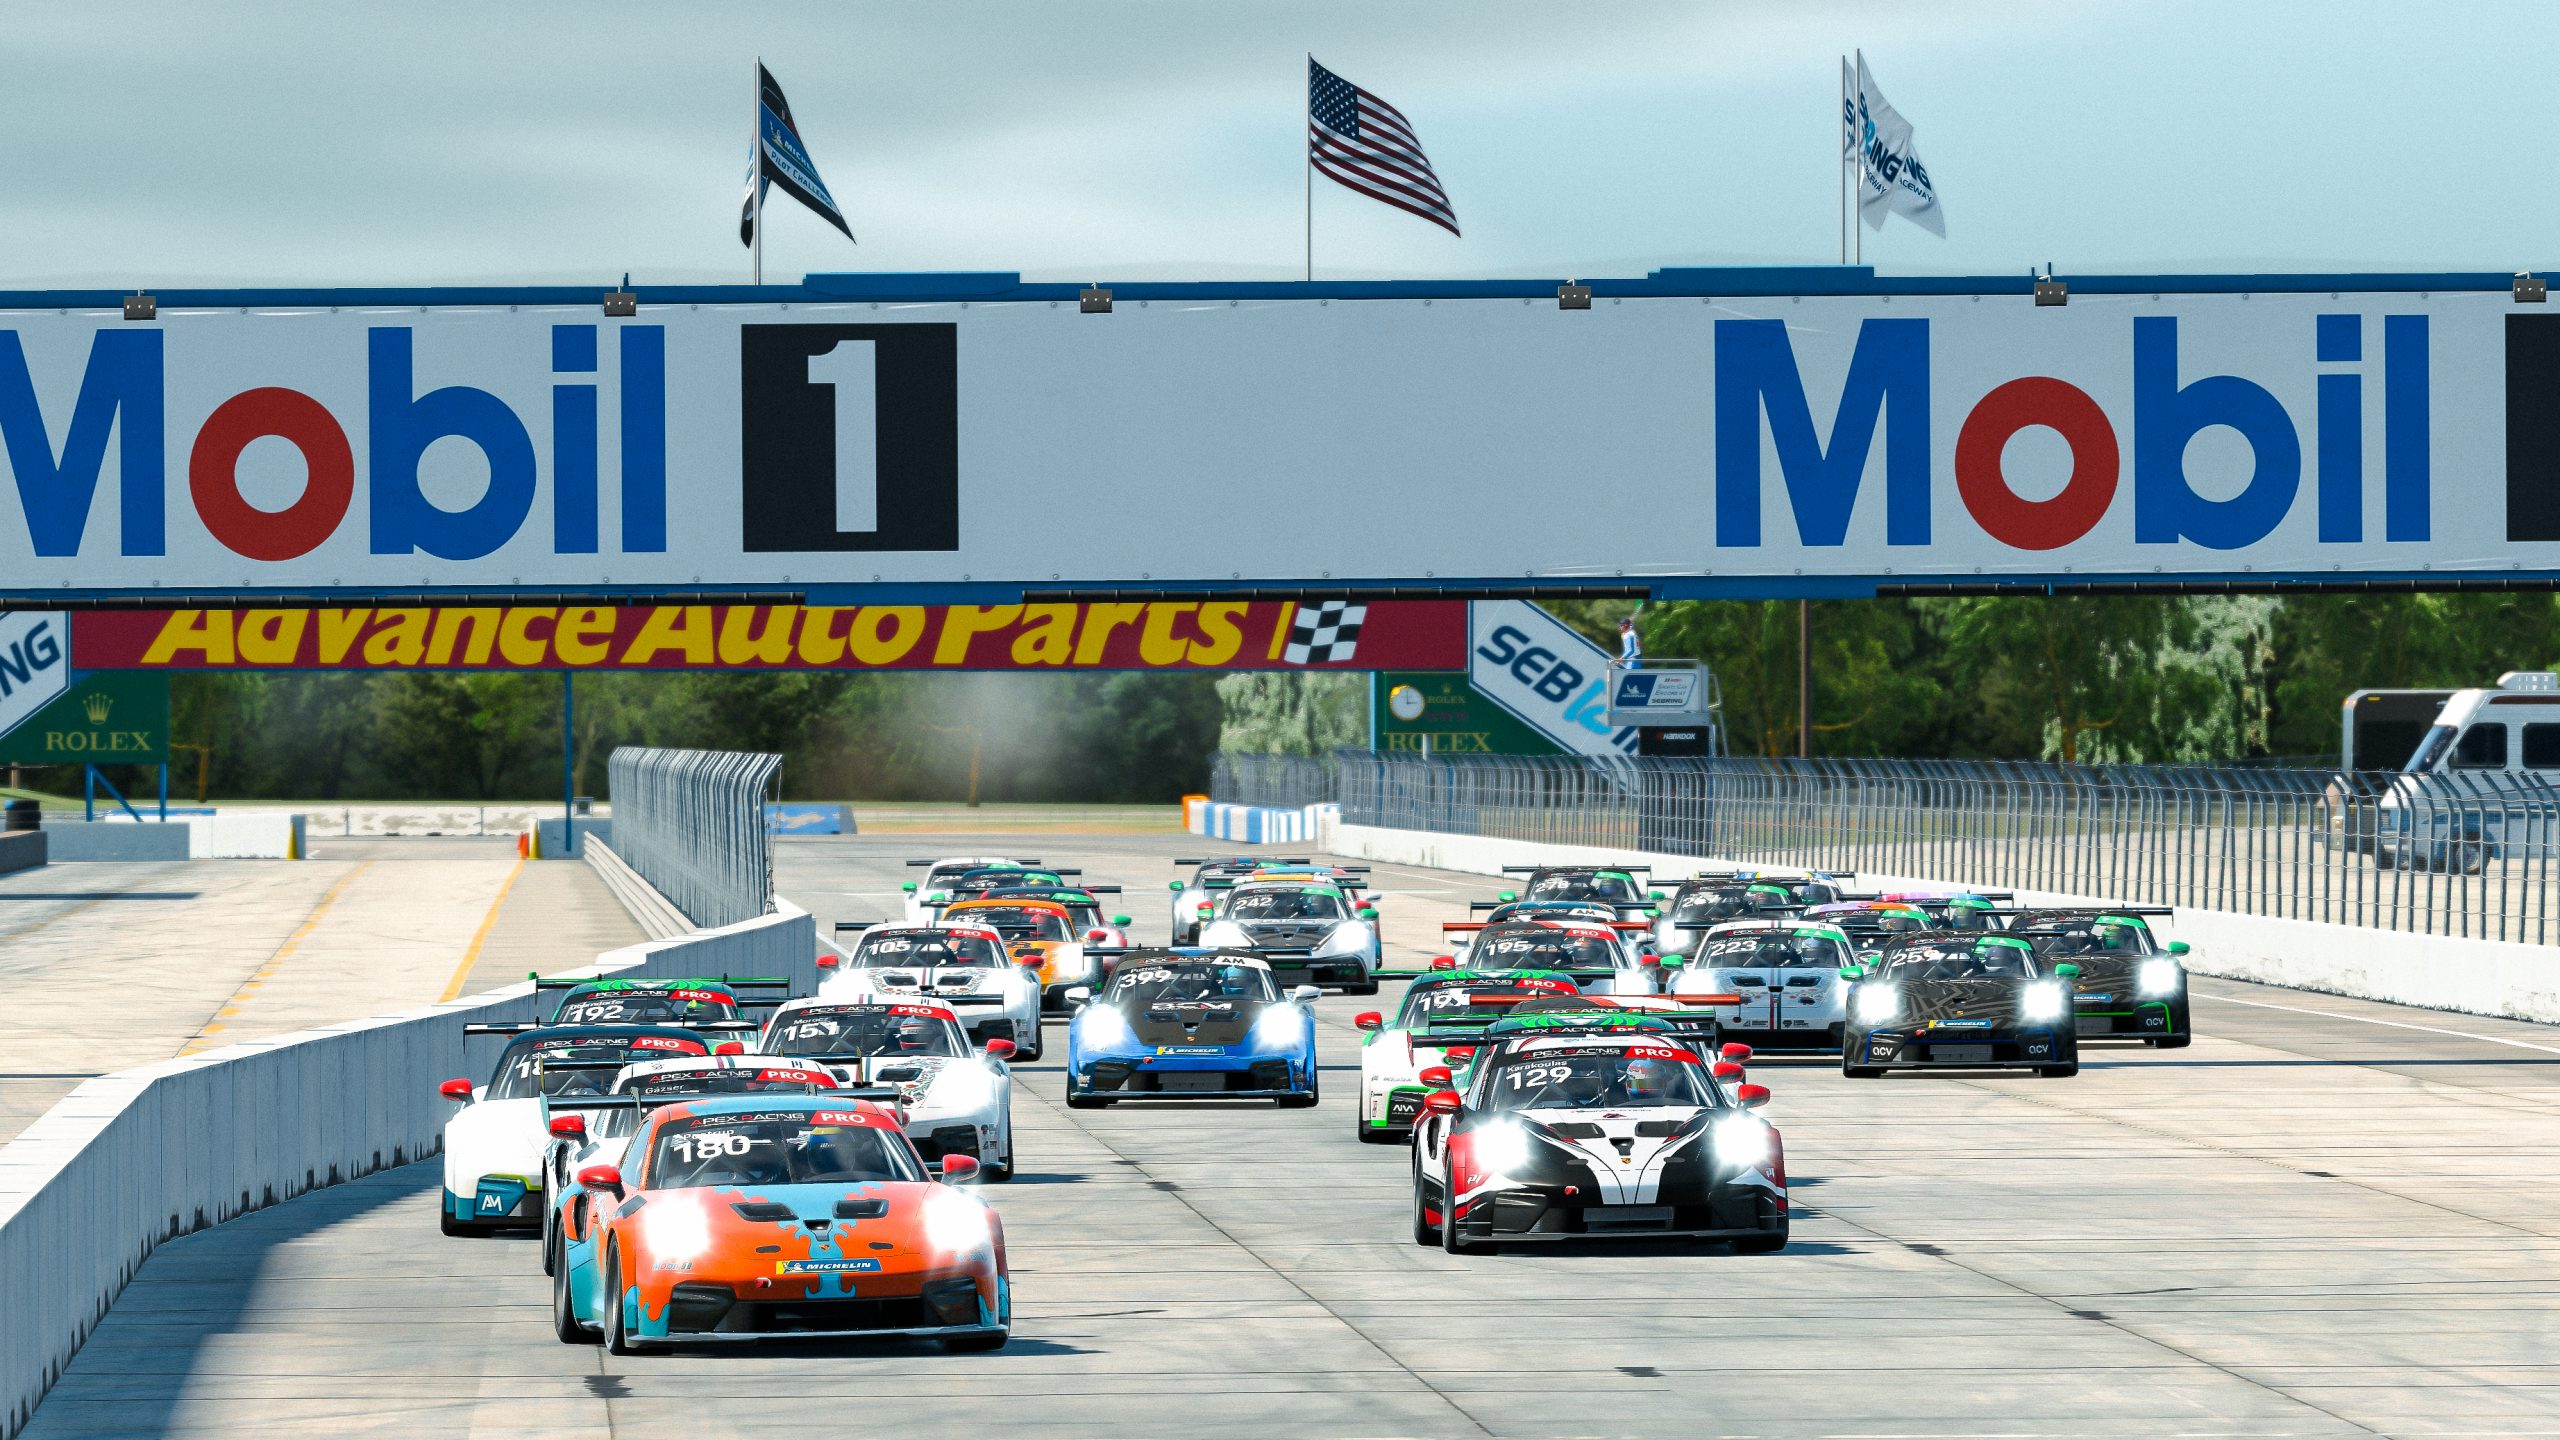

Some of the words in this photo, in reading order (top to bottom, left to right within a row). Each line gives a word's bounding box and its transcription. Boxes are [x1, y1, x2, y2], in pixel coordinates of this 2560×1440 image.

[771, 150, 791, 172] PILOT
[1714, 314, 2431, 550] Mobil
[0, 324, 667, 562] Mobil
[807, 339, 878, 533] 1
[140, 607, 619, 667] Advance
[620, 605, 927, 667] Auto
[932, 601, 1250, 666] Parts
[0, 620, 61, 701] NG
[46, 731, 153, 751] ROLEX
[1235, 897, 1273, 911] 242
[1572, 929, 1599, 937] PRO
[868, 940, 912, 956] 105
[1486, 940, 1530, 956] 195
[1710, 940, 1758, 957] 223
[1119, 969, 1172, 988] 399
[1523, 980, 1556, 988] PRO
[679, 990, 712, 999] PRO
[570, 1005, 623, 1022] 192
[897, 1006, 932, 1015] PRO
[533, 1040, 573, 1049] APEX
[641, 1039, 680, 1048] PRO
[1522, 1049, 1563, 1060] APEX
[1634, 1048, 1673, 1058] PRO
[1507, 1060, 1568, 1073] Karakoulas
[649, 1073, 692, 1084] APEX
[767, 1071, 808, 1081] PRO
[1505, 1066, 1572, 1090] 129
[690, 1115, 738, 1128] APEX
[820, 1112, 866, 1124] PRO
[673, 1134, 751, 1164] 180
[481, 1194, 503, 1212] AM
[806, 1261, 872, 1270] MICHELIN
